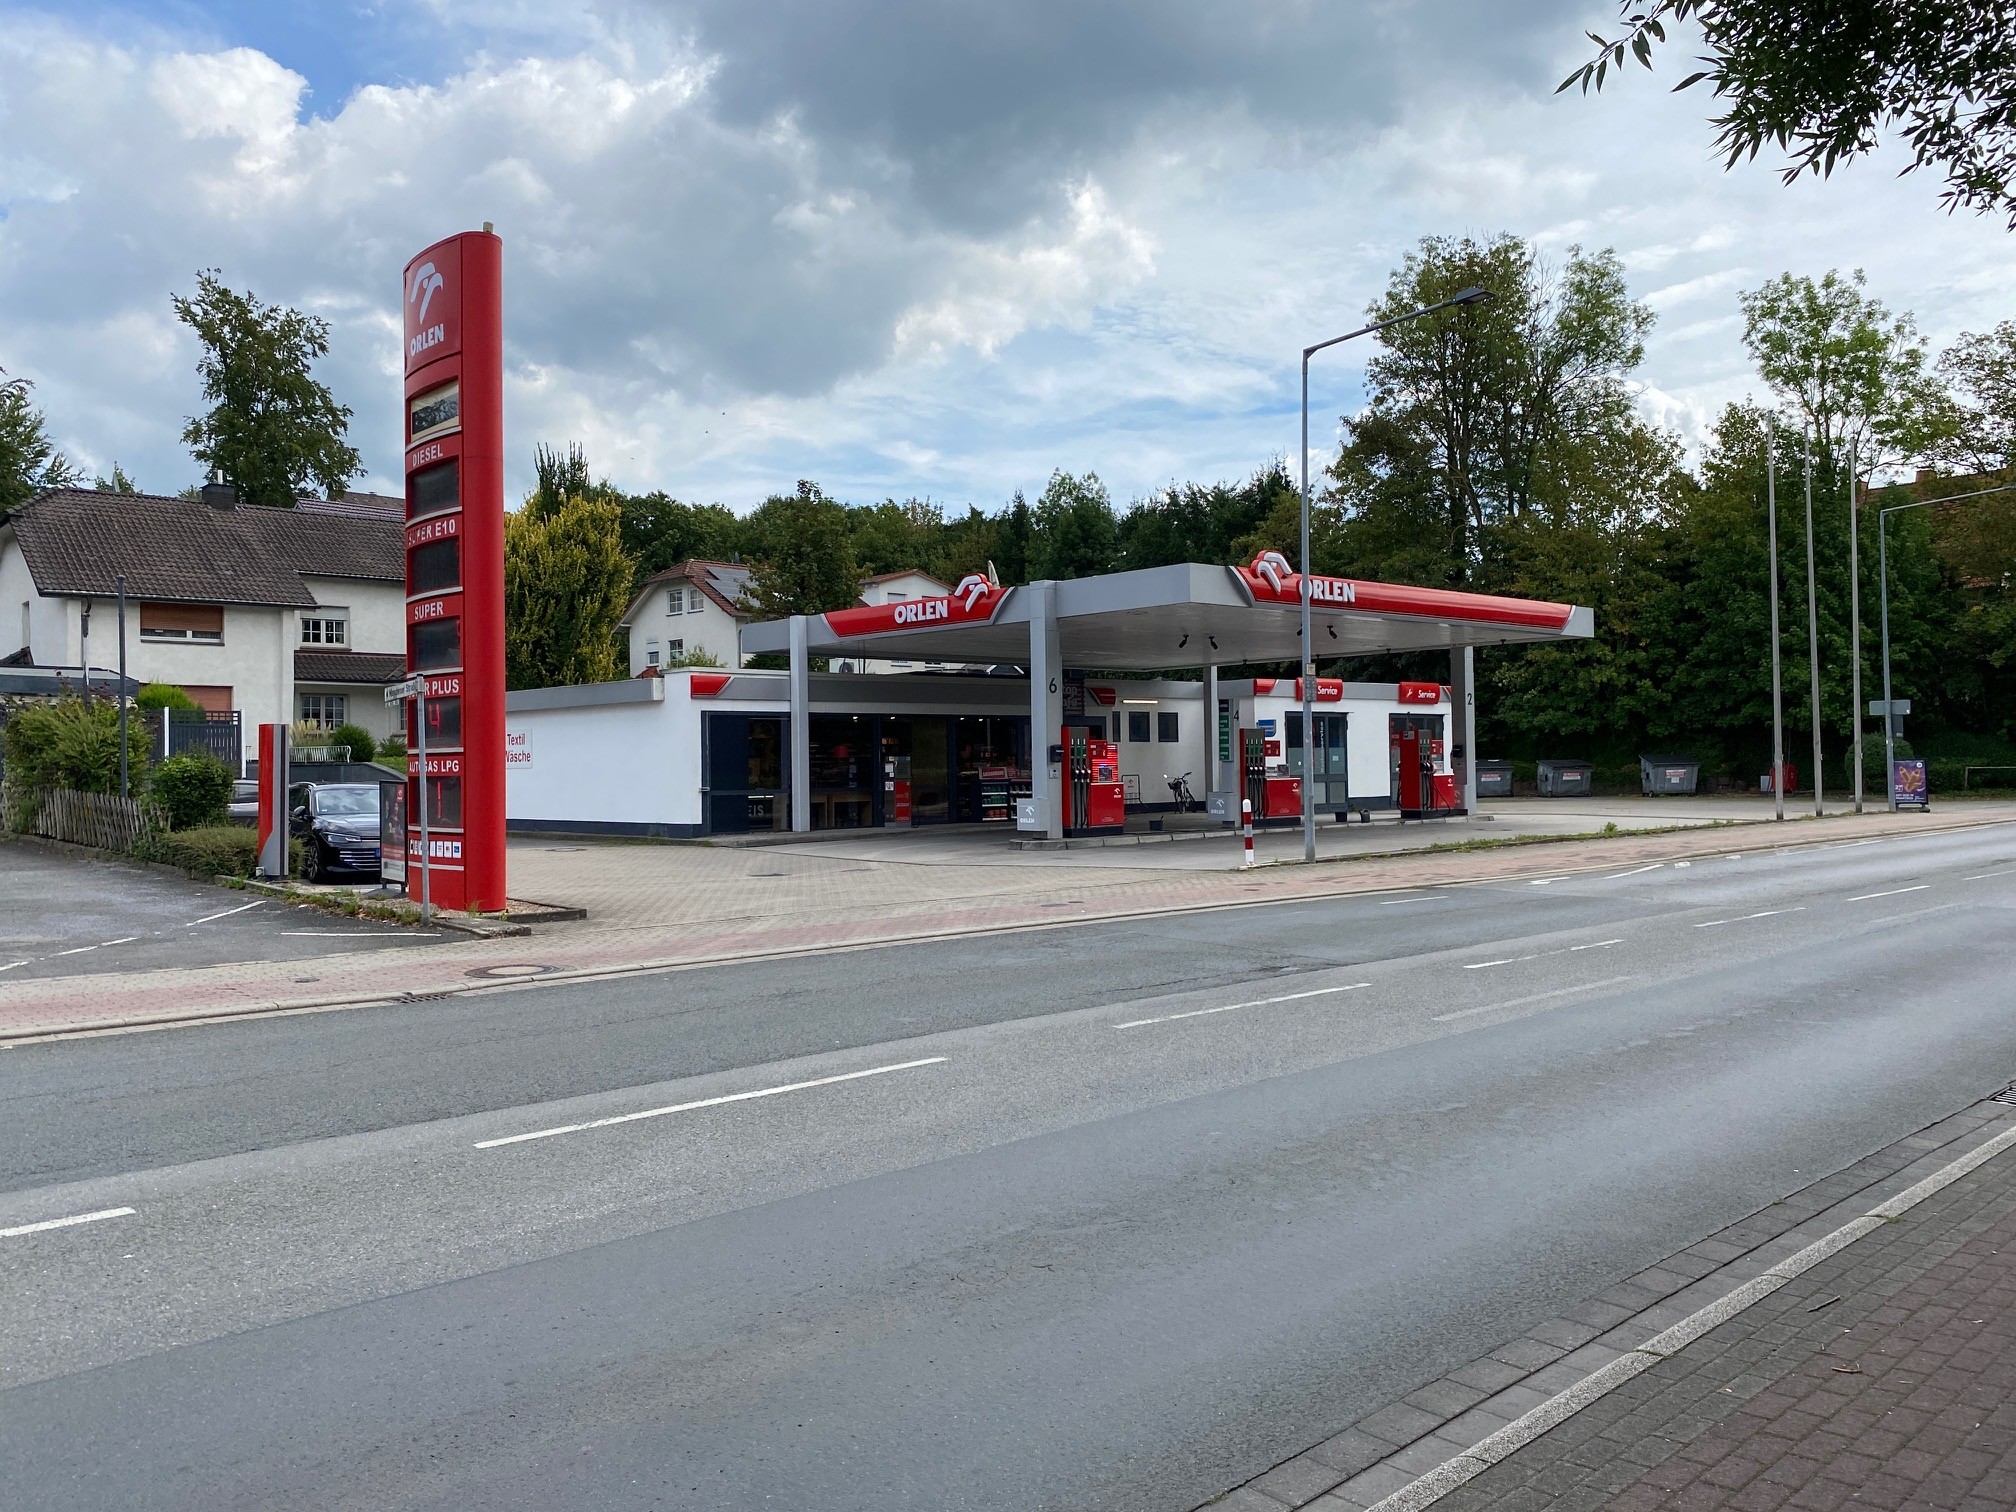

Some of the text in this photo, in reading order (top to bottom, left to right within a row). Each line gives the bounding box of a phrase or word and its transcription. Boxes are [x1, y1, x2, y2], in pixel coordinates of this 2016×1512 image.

[410, 323, 444, 357] ORLEN
[412, 443, 444, 468] DIESEL
[435, 519, 456, 537] E10
[414, 601, 444, 620] SUPER
[894, 600, 948, 624] ORLEN
[432, 679, 460, 695] PLUS
[1049, 677, 1057, 694] 6
[1317, 685, 1338, 695] Service
[1418, 689, 1436, 699] Service
[1467, 693, 1472, 705] 2
[1233, 709, 1239, 721] 4
[507, 732, 526, 746] Textil
[441, 760, 460, 772] LPG
